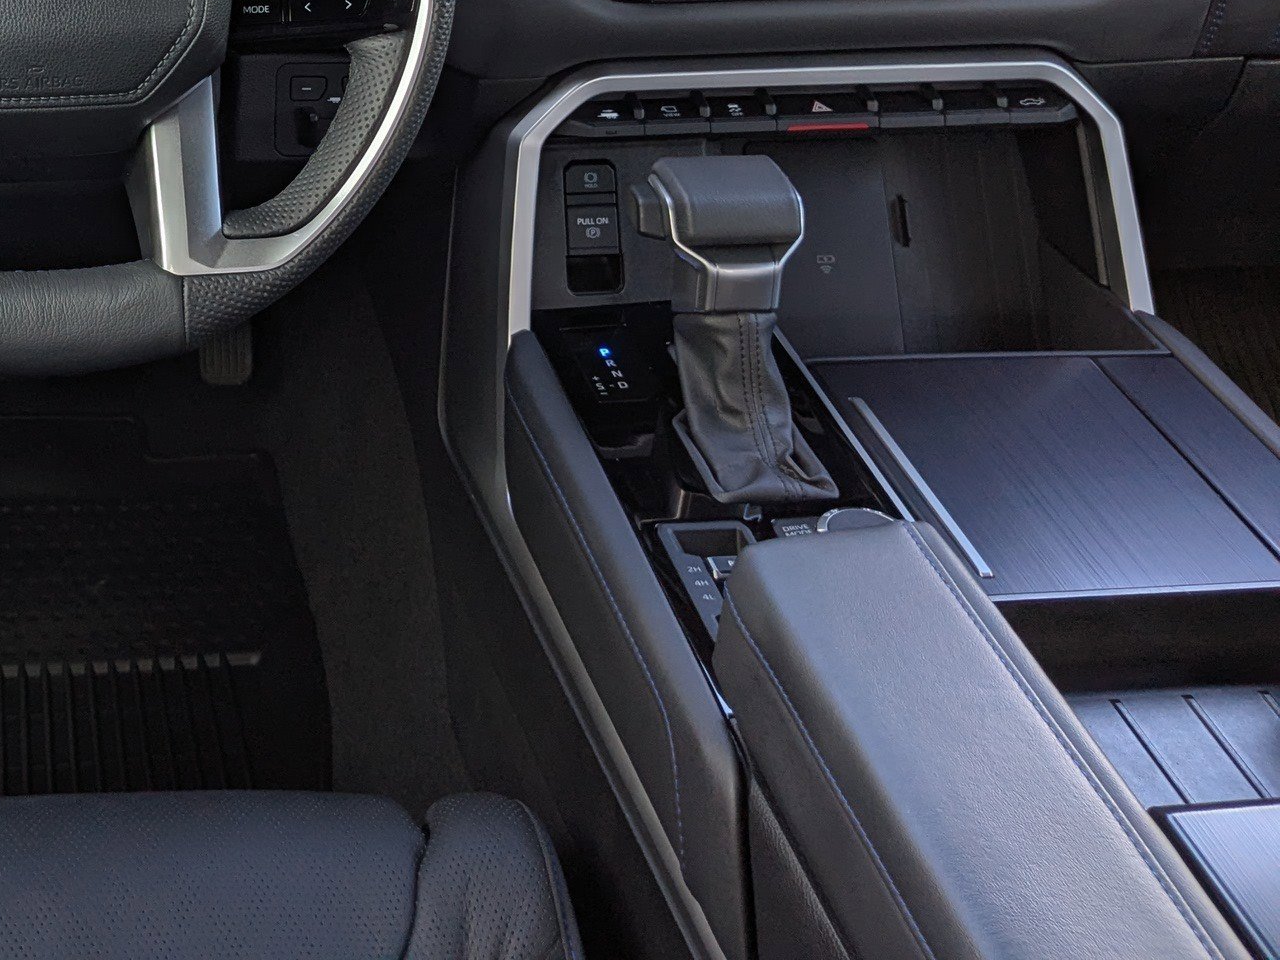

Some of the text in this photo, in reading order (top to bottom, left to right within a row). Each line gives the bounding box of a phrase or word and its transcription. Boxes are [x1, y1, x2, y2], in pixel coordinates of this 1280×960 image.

[243, 5, 270, 14] MODE
[577, 217, 609, 226] PULL ON
[599, 348, 610, 357] P
[605, 359, 617, 367] R
[611, 370, 623, 378] N
[617, 381, 629, 389] D
[782, 523, 810, 532] DRIVE
